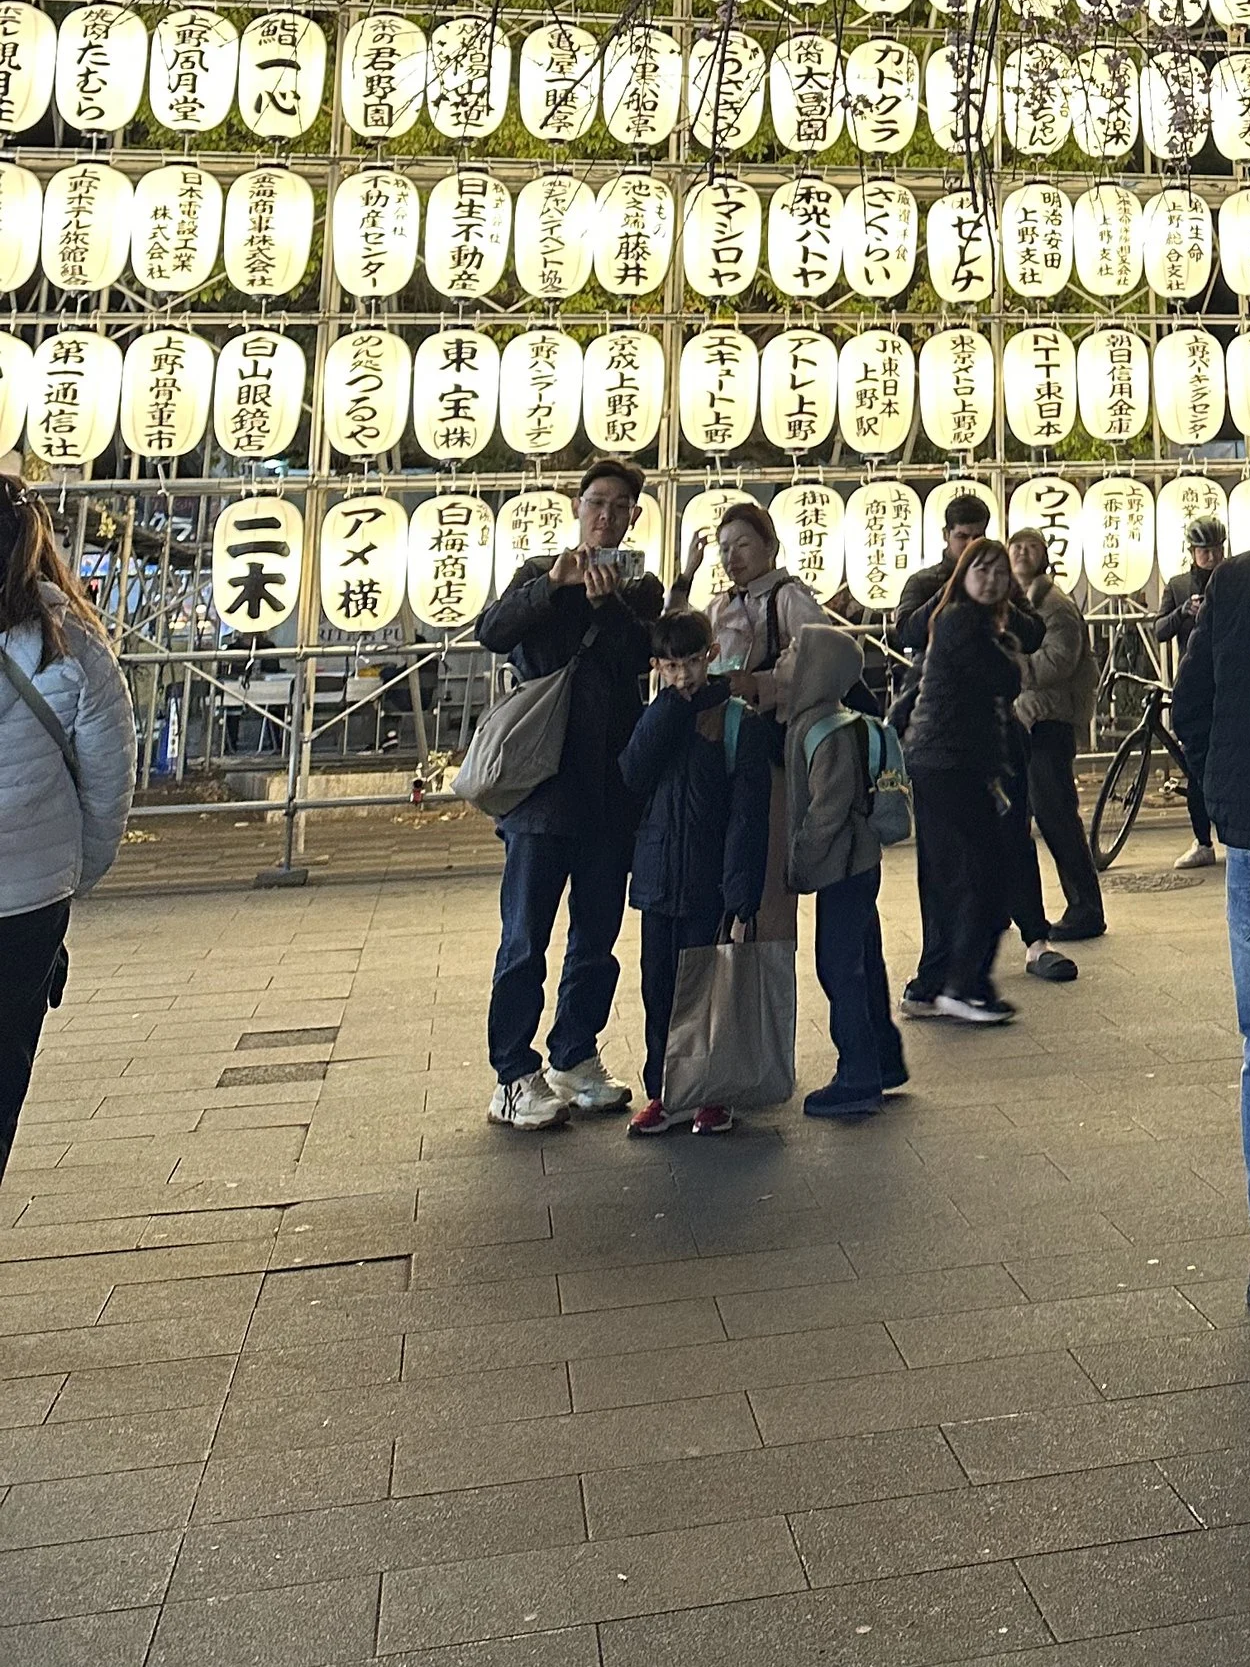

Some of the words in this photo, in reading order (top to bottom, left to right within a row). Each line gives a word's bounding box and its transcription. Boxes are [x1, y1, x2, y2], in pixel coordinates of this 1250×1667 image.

[76, 9, 113, 122] 焼肉たむら
[167, 13, 213, 123] 上野風月堂
[254, 19, 302, 116] 鮨一心
[870, 45, 906, 144] カドクラ
[58, 169, 101, 285] 上野ホテル旅館組合
[146, 205, 174, 280] 株式会社
[172, 172, 205, 273] 日本電設工業
[243, 173, 284, 288] 金海商事株式会社
[360, 175, 390, 288] 不動産センター
[392, 179, 412, 238] 株式会社
[447, 178, 488, 291] 日生不動産
[488, 183, 506, 245] 株式会社
[615, 180, 651, 287] 池之端藤井
[651, 186, 669, 238] きもの
[708, 183, 748, 288] ヤマシロヤ
[793, 185, 832, 288] 和光ハトヤ
[864, 187, 896, 286] さくらい
[1016, 209, 1043, 285] 上野支社
[1041, 191, 1063, 269] 明治安田
[1098, 217, 1115, 278] 上野支社
[1187, 198, 1205, 263] 第一生命
[40, 339, 89, 458] 第一通信社
[144, 336, 186, 451] 上野骨董市
[231, 337, 278, 453] 白山眼鏡店
[345, 335, 383, 449] めん処つるや
[432, 337, 481, 450] 東宝(株)
[604, 335, 640, 443] 京成上野駅
[702, 336, 742, 444] エキュート上野
[784, 337, 821, 441] アトレ上野
[855, 363, 880, 438] 上野駅
[876, 339, 903, 418] JR東日本
[950, 335, 978, 444] 東京メトロ上野駅
[1033, 333, 1064, 437] NTT東日本
[1105, 334, 1136, 435] 朝日信用金庫
[1186, 335, 1211, 440] 上野パーキングセンター
[336, 506, 386, 619] アメ横
[429, 502, 473, 624] 白梅商店会
[891, 490, 912, 570] 上野六丁目
[1102, 490, 1125, 587] 一番街商店会
[1126, 485, 1144, 542] 上野駅前
[224, 516, 290, 619] 二木
